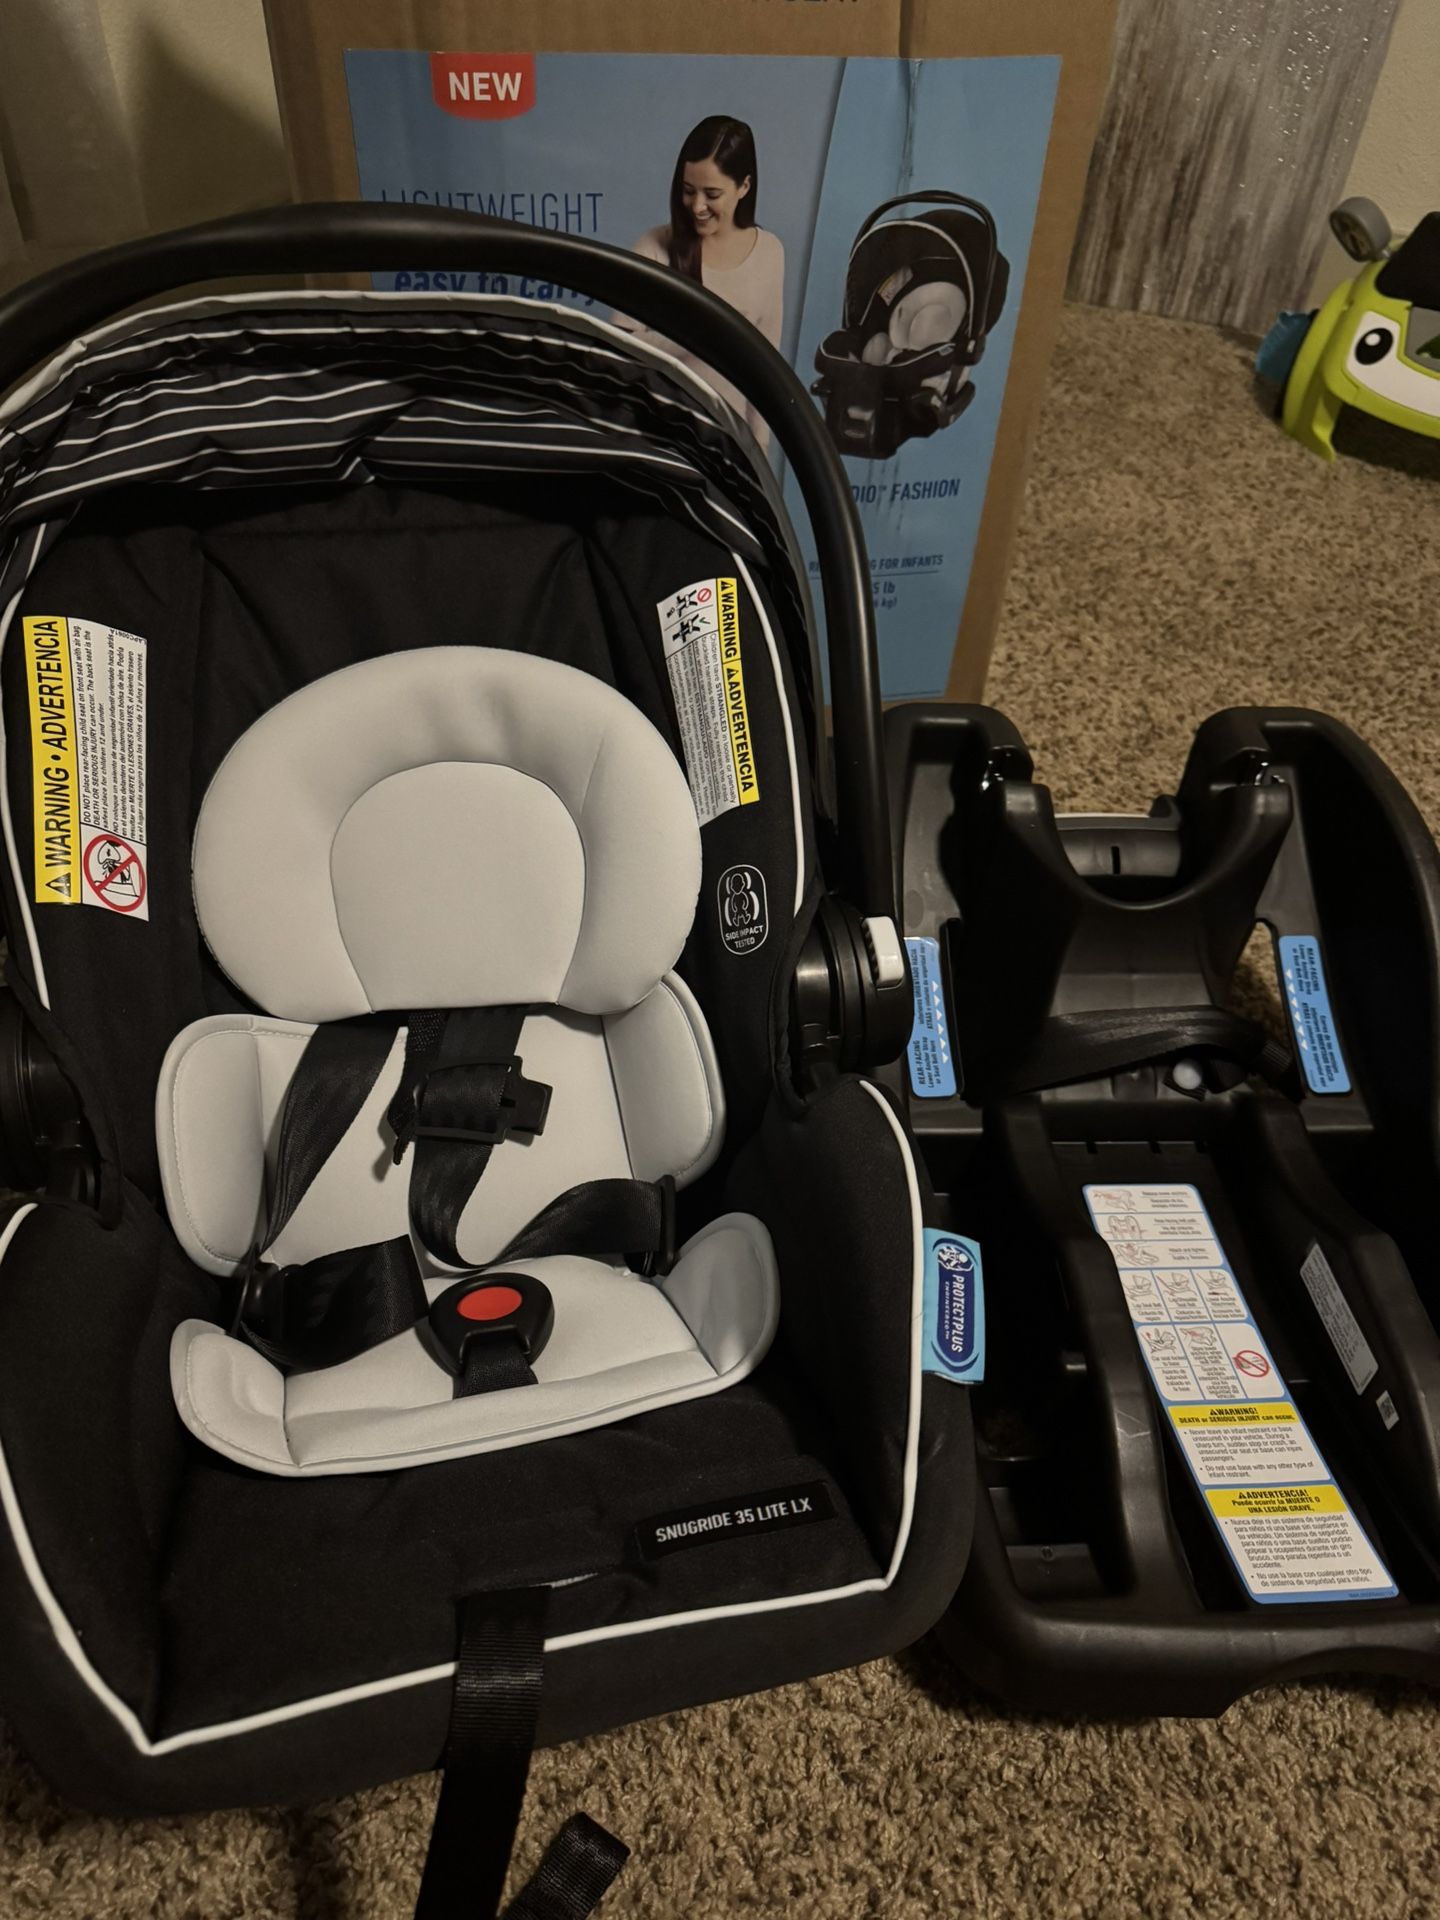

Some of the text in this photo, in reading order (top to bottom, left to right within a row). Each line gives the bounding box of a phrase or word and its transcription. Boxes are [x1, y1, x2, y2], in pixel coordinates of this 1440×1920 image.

[448, 72, 522, 101] NEW
[891, 479, 960, 502] FASHION
[879, 559, 898, 570] FOR
[901, 554, 944, 568] INFANTS
[722, 592, 738, 660] WARNING
[709, 632, 718, 663] Children
[78, 693, 84, 702] on
[715, 683, 727, 732] STRANGLED
[136, 714, 142, 722] de
[99, 737, 105, 745] 12
[110, 718, 118, 750] seguridad
[728, 681, 752, 792] ADVERTENCIA
[34, 620, 72, 868] WARNING ADVERTENCIA
[81, 736, 89, 772] rear-facing
[726, 764, 731, 772] or
[92, 787, 98, 799] OR
[726, 774, 736, 803] partially
[83, 811, 90, 822] DO
[130, 804, 134, 813] en
[122, 827, 126, 836] en
[725, 925, 764, 940] SIDE IMPACT
[734, 936, 756, 948] TESTED
[1308, 948, 1320, 992] REAR-FACING
[914, 1040, 925, 1084] REAR-FACING
[952, 1274, 965, 1352] PROTECTPLUS
[1216, 1407, 1258, 1416] WARNING!
[1246, 1489, 1308, 1499] ADVERTENCIA!
[1263, 1504, 1288, 1513] LESIÓN
[655, 1498, 812, 1542] SNUGRIDE 35 LITE LX
